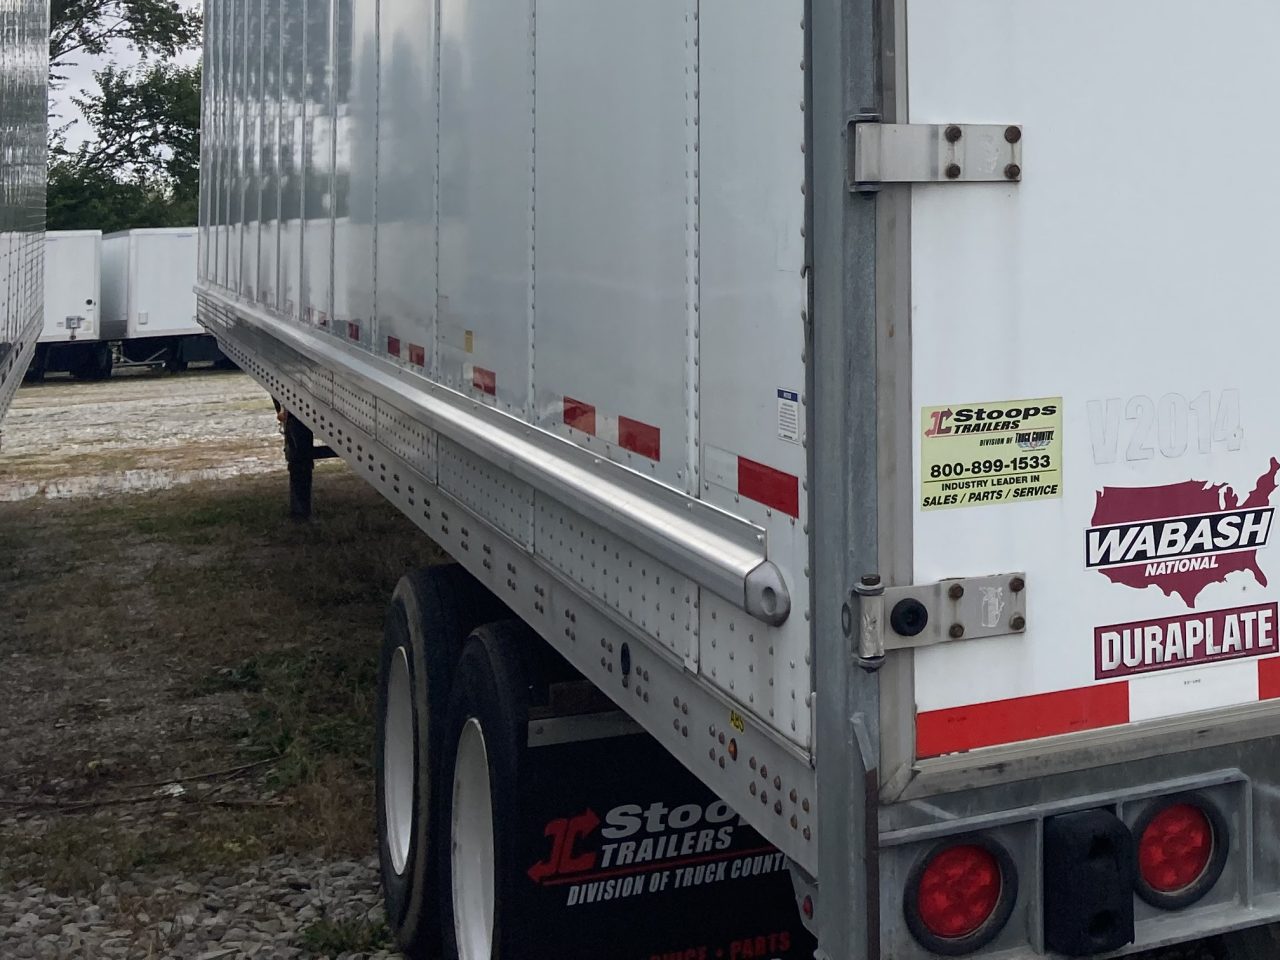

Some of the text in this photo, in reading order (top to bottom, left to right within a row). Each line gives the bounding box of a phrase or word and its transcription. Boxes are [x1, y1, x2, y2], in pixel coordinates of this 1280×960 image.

[953, 405, 1057, 423] Stoops
[1086, 389, 1244, 465] V2014
[954, 420, 1021, 435] TRAILERS
[979, 438, 1005, 447] DIVISION
[1006, 436, 1014, 445] OF
[930, 455, 1051, 478] 800-899-1533
[922, 494, 958, 507] SALES
[968, 489, 1003, 503] PARTS
[1012, 484, 1058, 498] SERVICE
[941, 474, 1040, 491] INDUSTRY LEADER IN
[1089, 510, 1272, 565] WABASH
[1144, 555, 1219, 577] NATIONAL
[1101, 608, 1273, 672] DURAPLATE
[601, 799, 750, 840] Stoo
[600, 826, 734, 868] TRAILERS
[567, 874, 645, 906] DIVISION
[649, 871, 670, 893] OF
[674, 861, 728, 889] TRUCK
[729, 930, 791, 960] PARTS
